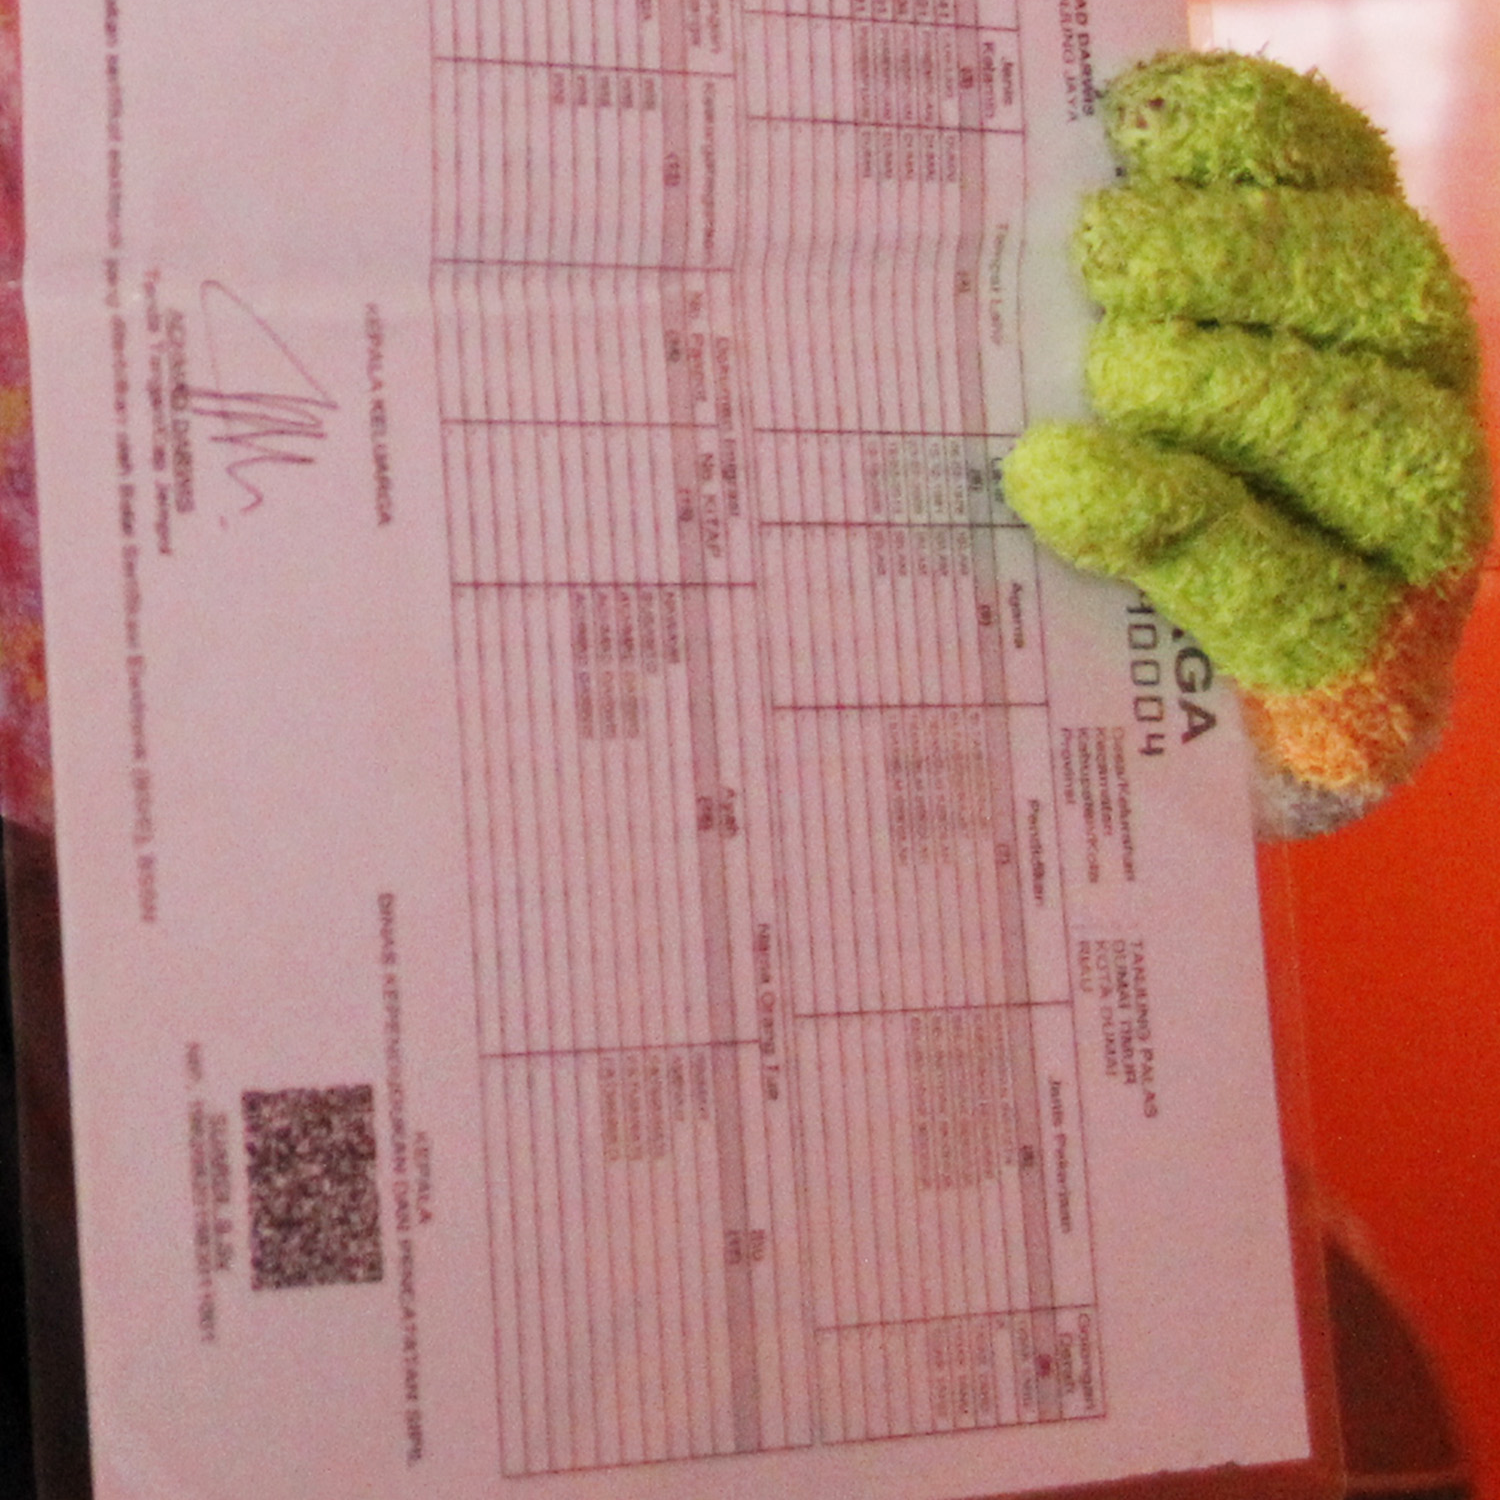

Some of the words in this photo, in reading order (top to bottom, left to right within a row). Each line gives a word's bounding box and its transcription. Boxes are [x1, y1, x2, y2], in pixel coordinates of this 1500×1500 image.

[1061, 71, 1080, 123] JAYA
[1076, 32, 1094, 116] DARWIS
[362, 302, 386, 394] KEPALA
[169, 419, 195, 514] DARWIS
[368, 398, 395, 528] KELUARGA
[1008, 581, 1024, 649] Agama
[1171, 628, 1216, 743] GA
[1059, 726, 1075, 806] Provinsi
[1075, 726, 1098, 884] Kabupaten/Kota
[1093, 726, 1113, 836] Kecamatan
[1111, 726, 1136, 882] Desa/Kelurahan
[1026, 799, 1045, 908] Pendidikan
[376, 891, 396, 966] DINAS
[753, 923, 770, 985] Nama
[1076, 939, 1093, 993] RIAU
[1093, 939, 1112, 999] KOTA
[1111, 939, 1131, 1015] DUMAI
[1129, 939, 1150, 1042] TANJUNG
[755, 991, 775, 1056] Orang
[1099, 1005, 1116, 1077] DUMAI
[1117, 1019, 1136, 1085] TIMUR
[382, 973, 406, 1173] KEPENDUDUKAN
[764, 1063, 780, 1102] Tua
[1139, 1048, 1158, 1119] PALAS
[392, 1179, 410, 1232] DAN
[412, 1130, 433, 1225] KEPALA
[1051, 1134, 1074, 1234] Pekerjaan
[398, 1238, 419, 1402] PENCATATAN
